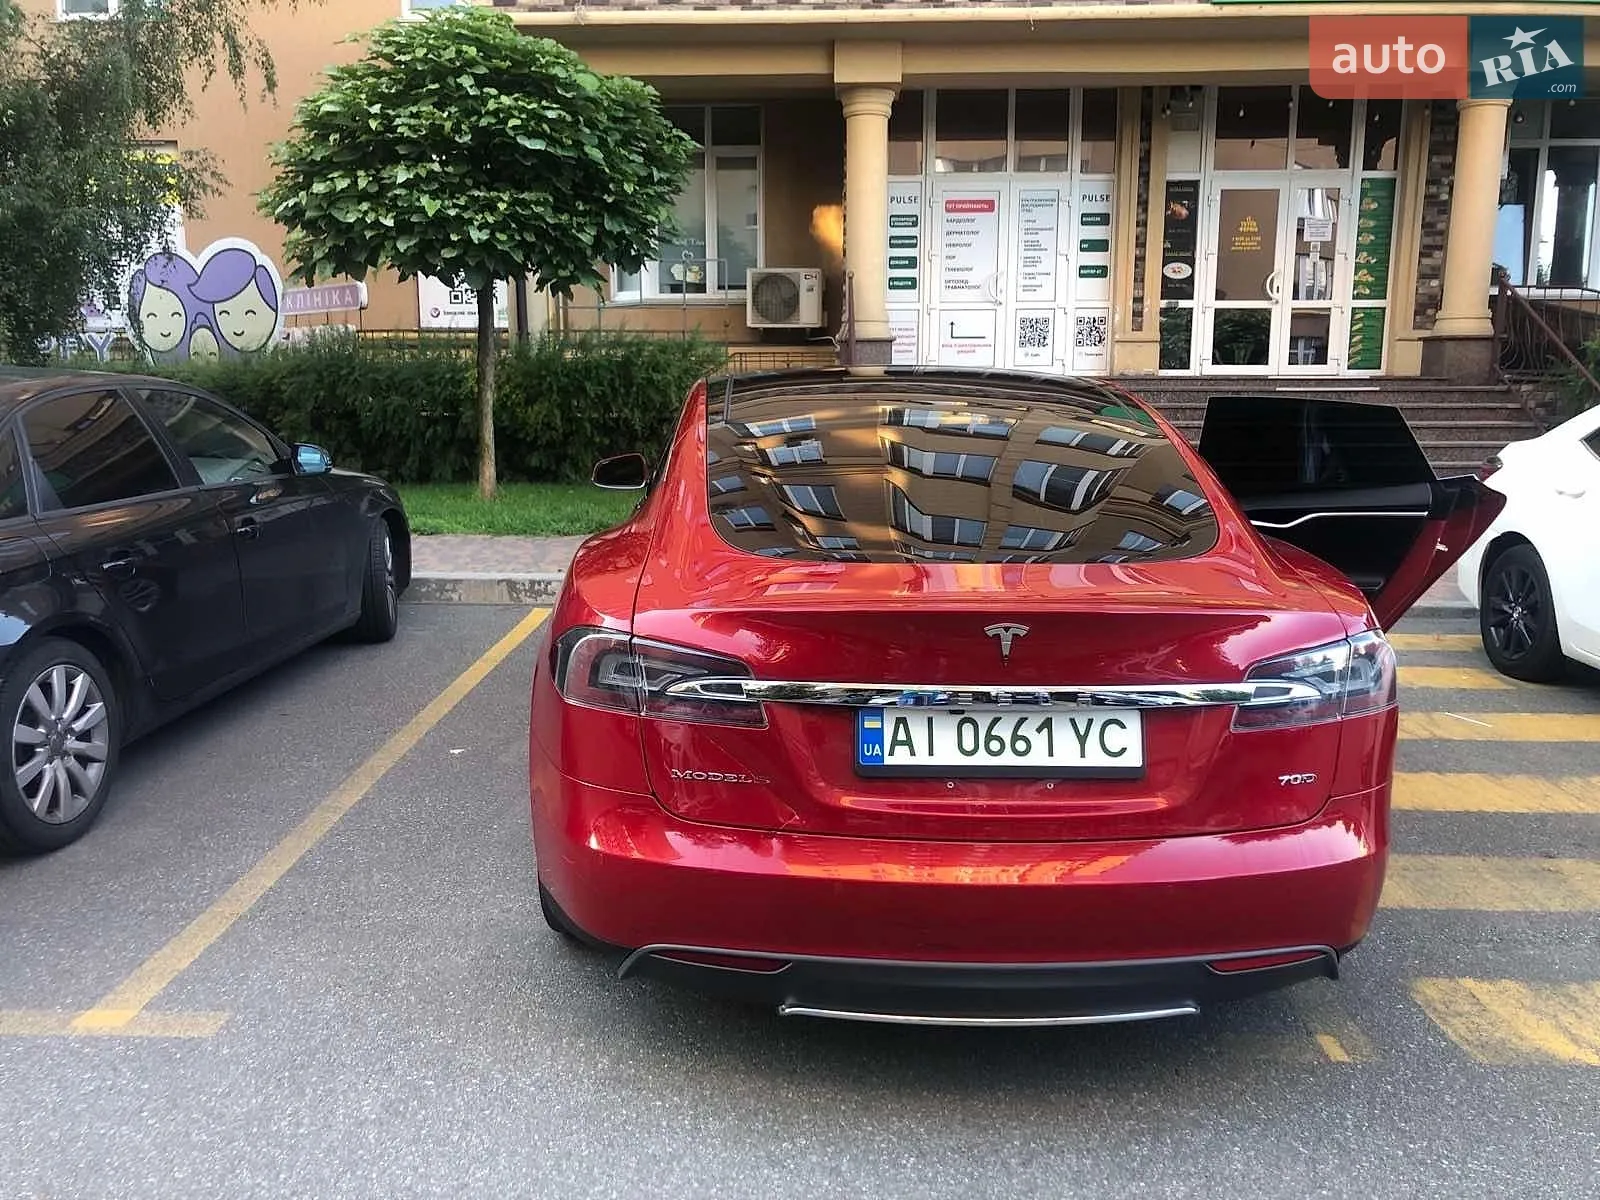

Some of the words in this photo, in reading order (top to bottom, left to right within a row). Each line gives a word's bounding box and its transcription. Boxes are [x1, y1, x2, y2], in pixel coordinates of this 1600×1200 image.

[890, 195, 919, 205] PULSE
[1082, 193, 1111, 203] PULSE
[286, 289, 353, 311] КЛІНІКА
[888, 716, 934, 757] AI
[956, 716, 1054, 758] 0661
[1068, 717, 1128, 758] YC
[864, 743, 882, 757] UA
[671, 768, 753, 783] MODEL
